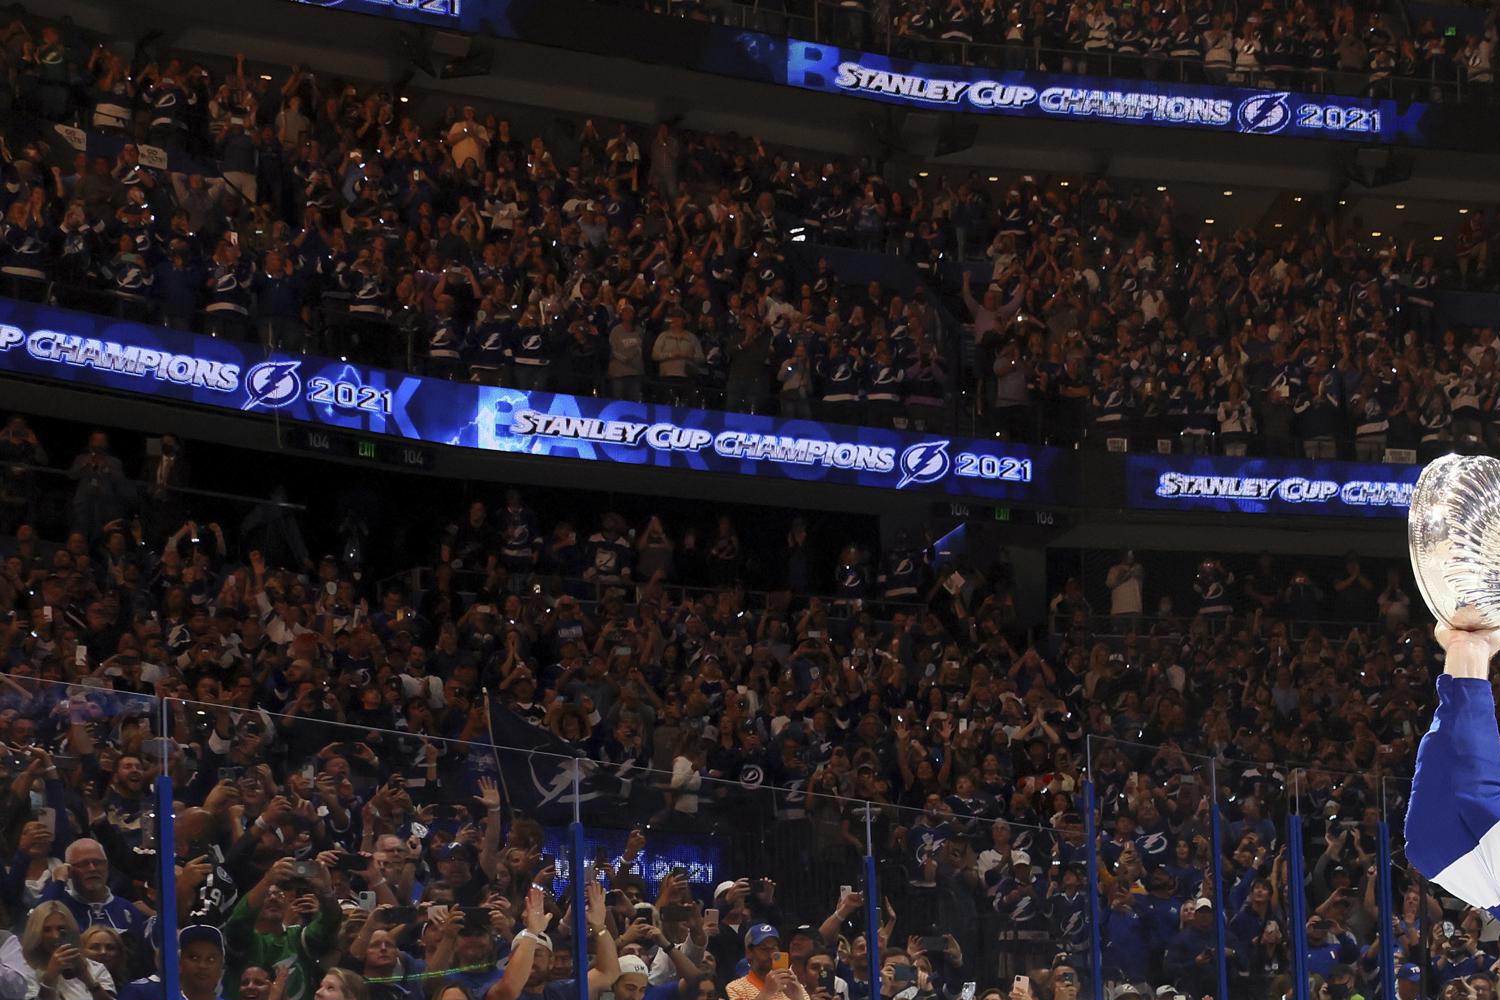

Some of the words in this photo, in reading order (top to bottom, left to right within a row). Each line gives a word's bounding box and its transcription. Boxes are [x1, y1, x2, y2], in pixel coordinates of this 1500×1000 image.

[835, 61, 970, 104] STANLEY
[967, 80, 1037, 108] CUP
[1039, 86, 1232, 125] CHAMPIONS
[1296, 103, 1381, 133] 2021
[26, 330, 240, 392] CHAMPIONS
[307, 377, 393, 415] 2021
[403, 449, 424, 465] 104
[510, 409, 651, 447] STANLEY
[645, 423, 713, 452] CUP
[714, 431, 895, 474] CHAMPIONS
[955, 452, 1033, 482] 2021
[1156, 471, 1281, 500] STANLEY
[1278, 476, 1341, 503] CUP
